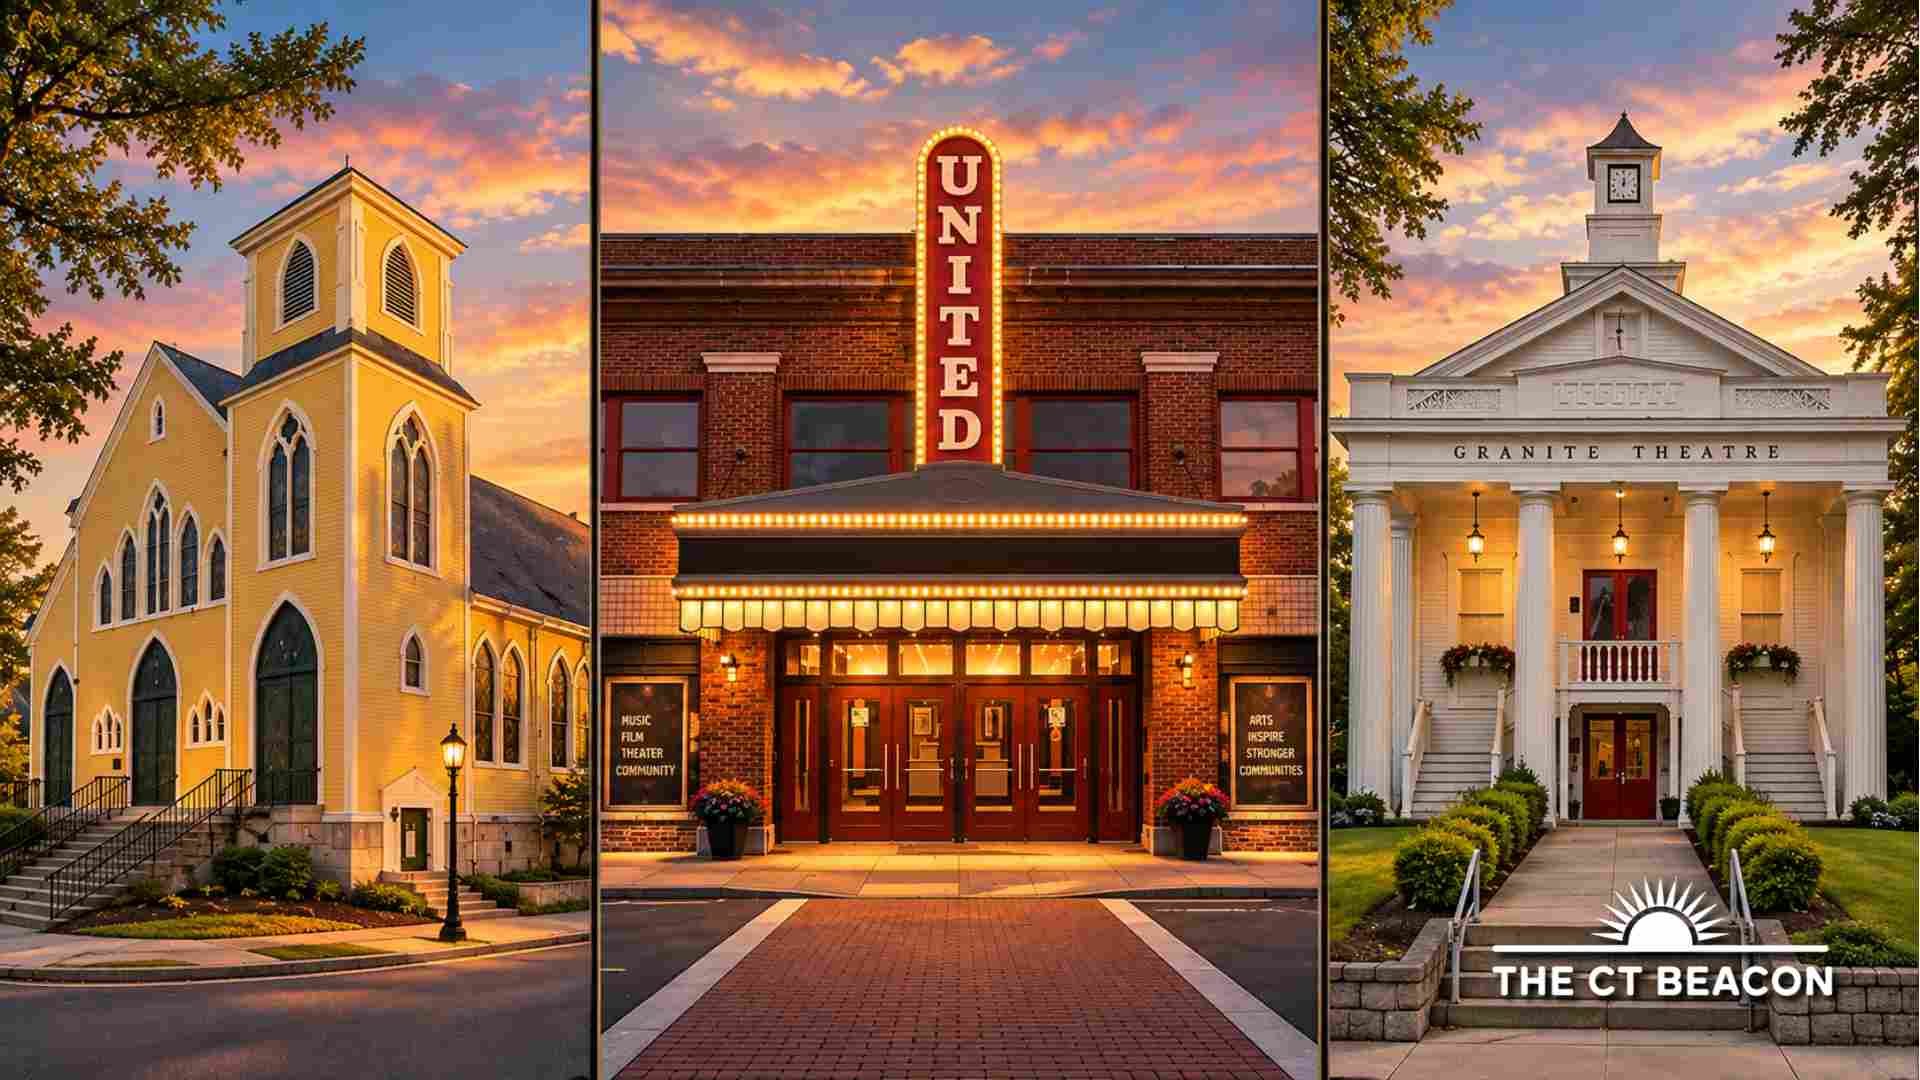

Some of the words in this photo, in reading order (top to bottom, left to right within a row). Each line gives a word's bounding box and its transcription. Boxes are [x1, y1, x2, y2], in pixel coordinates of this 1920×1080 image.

[936, 155, 982, 451] UNITED
[1454, 445, 1600, 460] GRANITE
[1633, 445, 1781, 460] THEATRE
[621, 714, 652, 726] MUSIC
[1249, 714, 1273, 726] ARTS
[621, 731, 644, 742] FILM
[1247, 731, 1285, 742] INSPIRE
[621, 747, 664, 759] THEATER
[1246, 747, 1295, 759] STRONGER
[616, 765, 675, 776] COMMUNITY
[1239, 765, 1304, 776] COMMUNITIES
